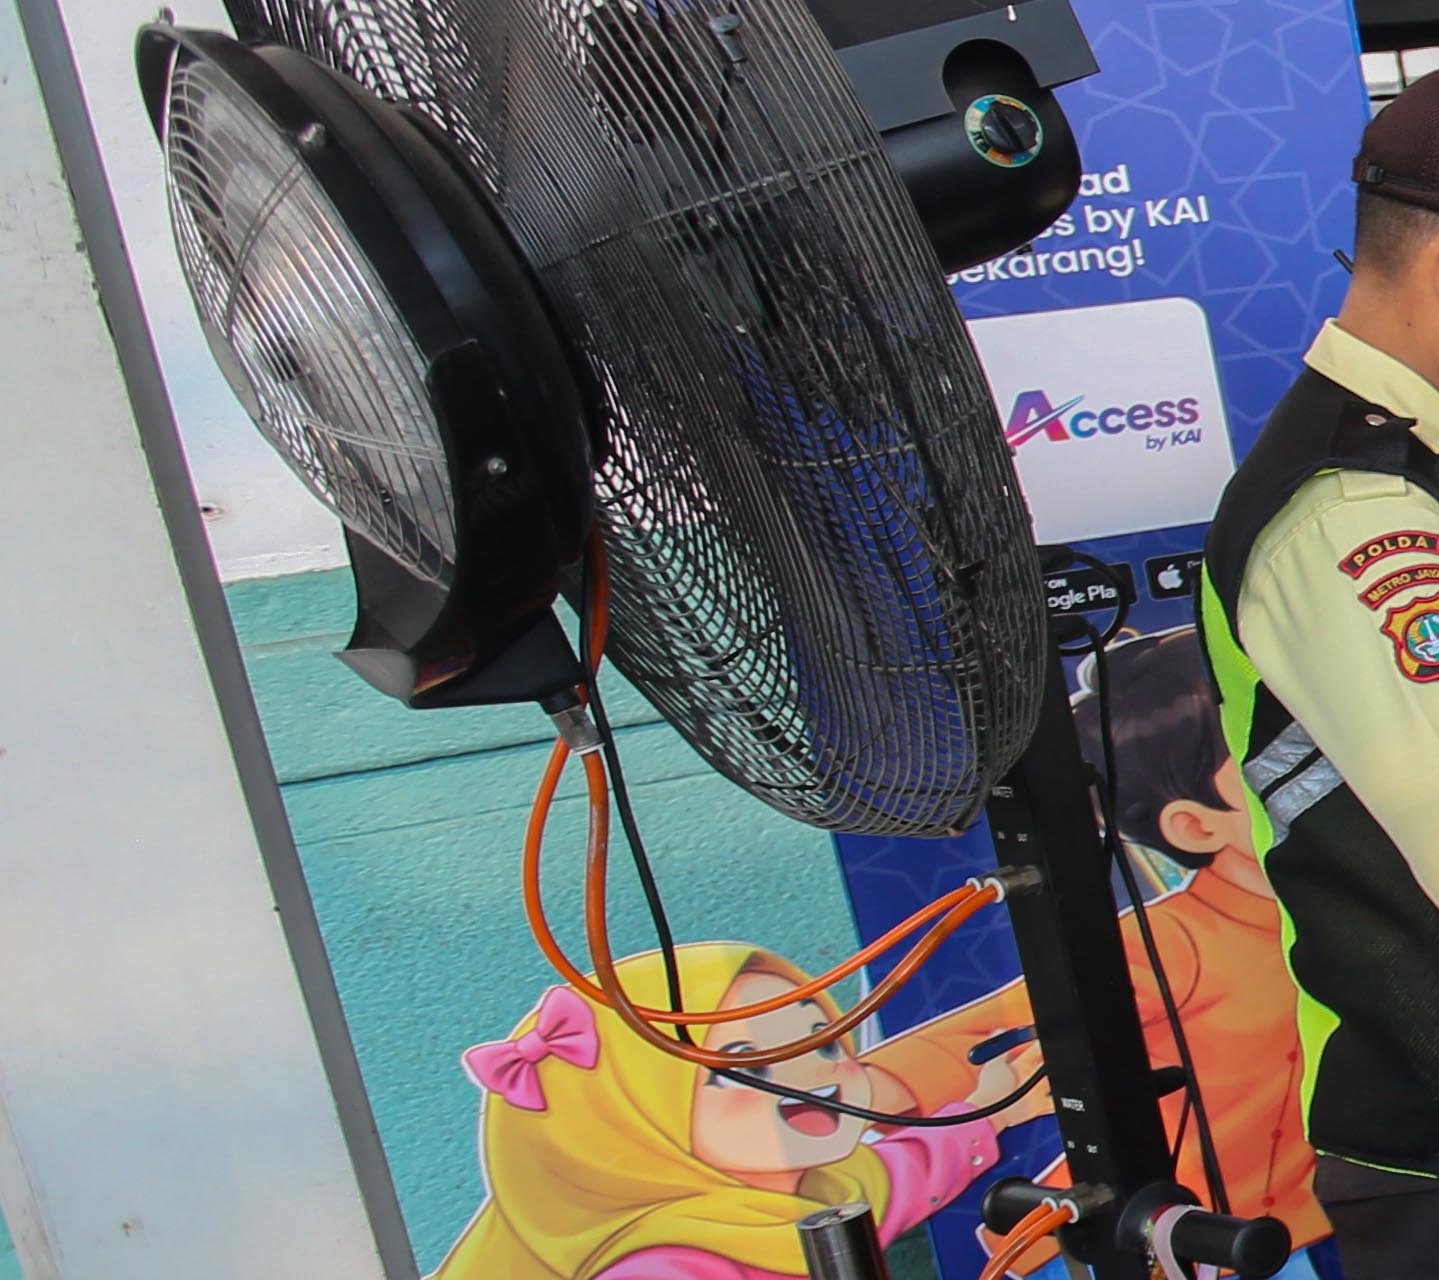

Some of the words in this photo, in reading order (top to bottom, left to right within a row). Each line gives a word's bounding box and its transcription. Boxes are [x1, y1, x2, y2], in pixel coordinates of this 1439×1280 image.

[1087, 201, 1134, 241] by
[1147, 194, 1209, 228] KAI
[1006, 389, 1199, 446] Access
[1146, 433, 1168, 451] by
[1171, 428, 1202, 448] KAI
[1353, 536, 1430, 567] POLDA
[1047, 592, 1085, 611] ogle
[1088, 585, 1119, 601] Pla
[1367, 572, 1412, 603] METRO
